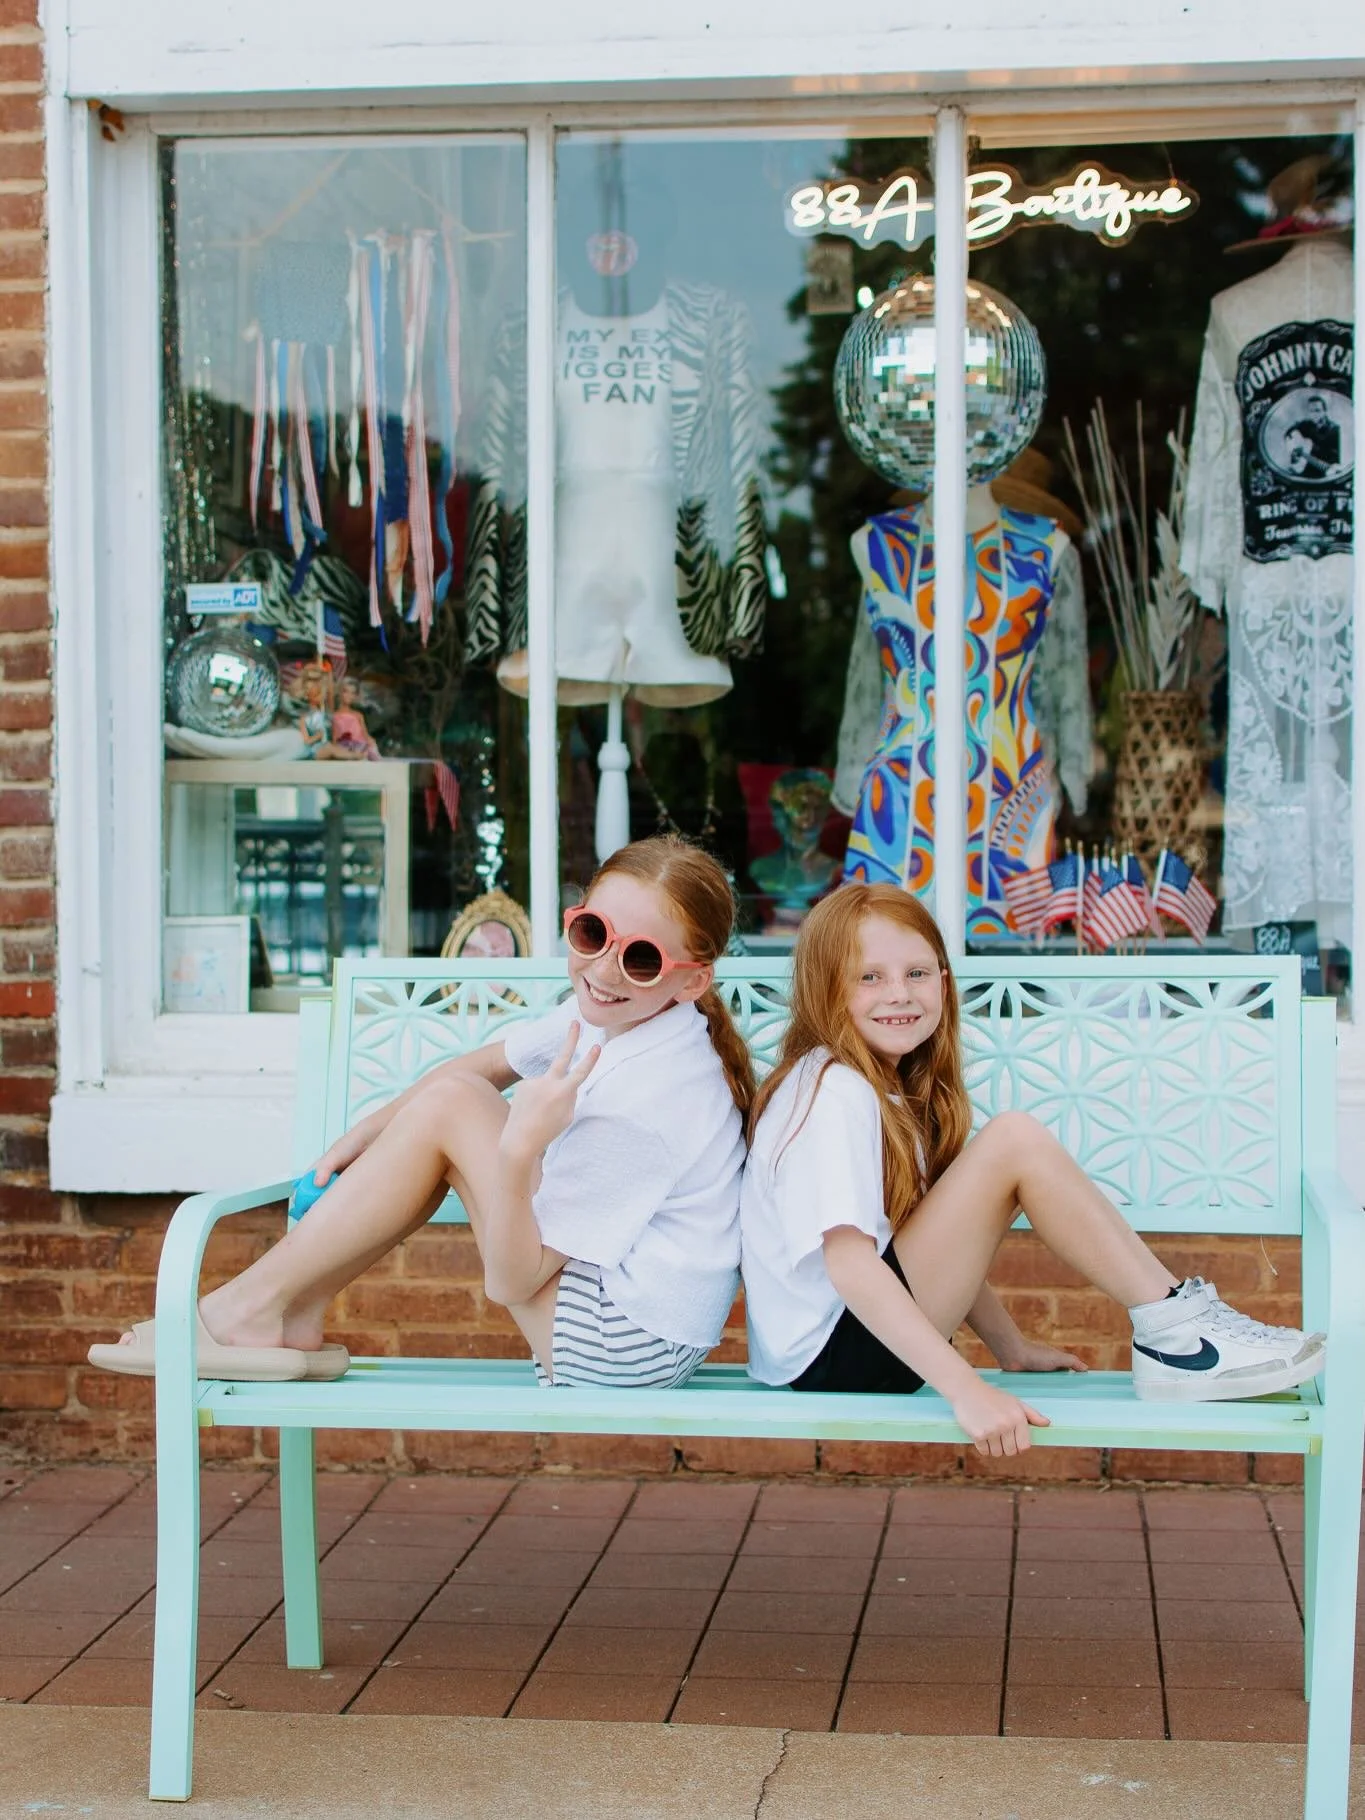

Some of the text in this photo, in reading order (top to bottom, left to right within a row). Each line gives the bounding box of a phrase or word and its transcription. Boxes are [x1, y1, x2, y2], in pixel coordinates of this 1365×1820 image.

[964, 168, 1193, 240] Boutique
[566, 328, 671, 344] MY EX
[568, 345, 672, 361] IS MY
[1328, 344, 1354, 376] CA
[563, 361, 672, 383] IGGES
[582, 383, 656, 404] FAN
[1304, 497, 1329, 512] OF
[1336, 496, 1354, 512] FI
